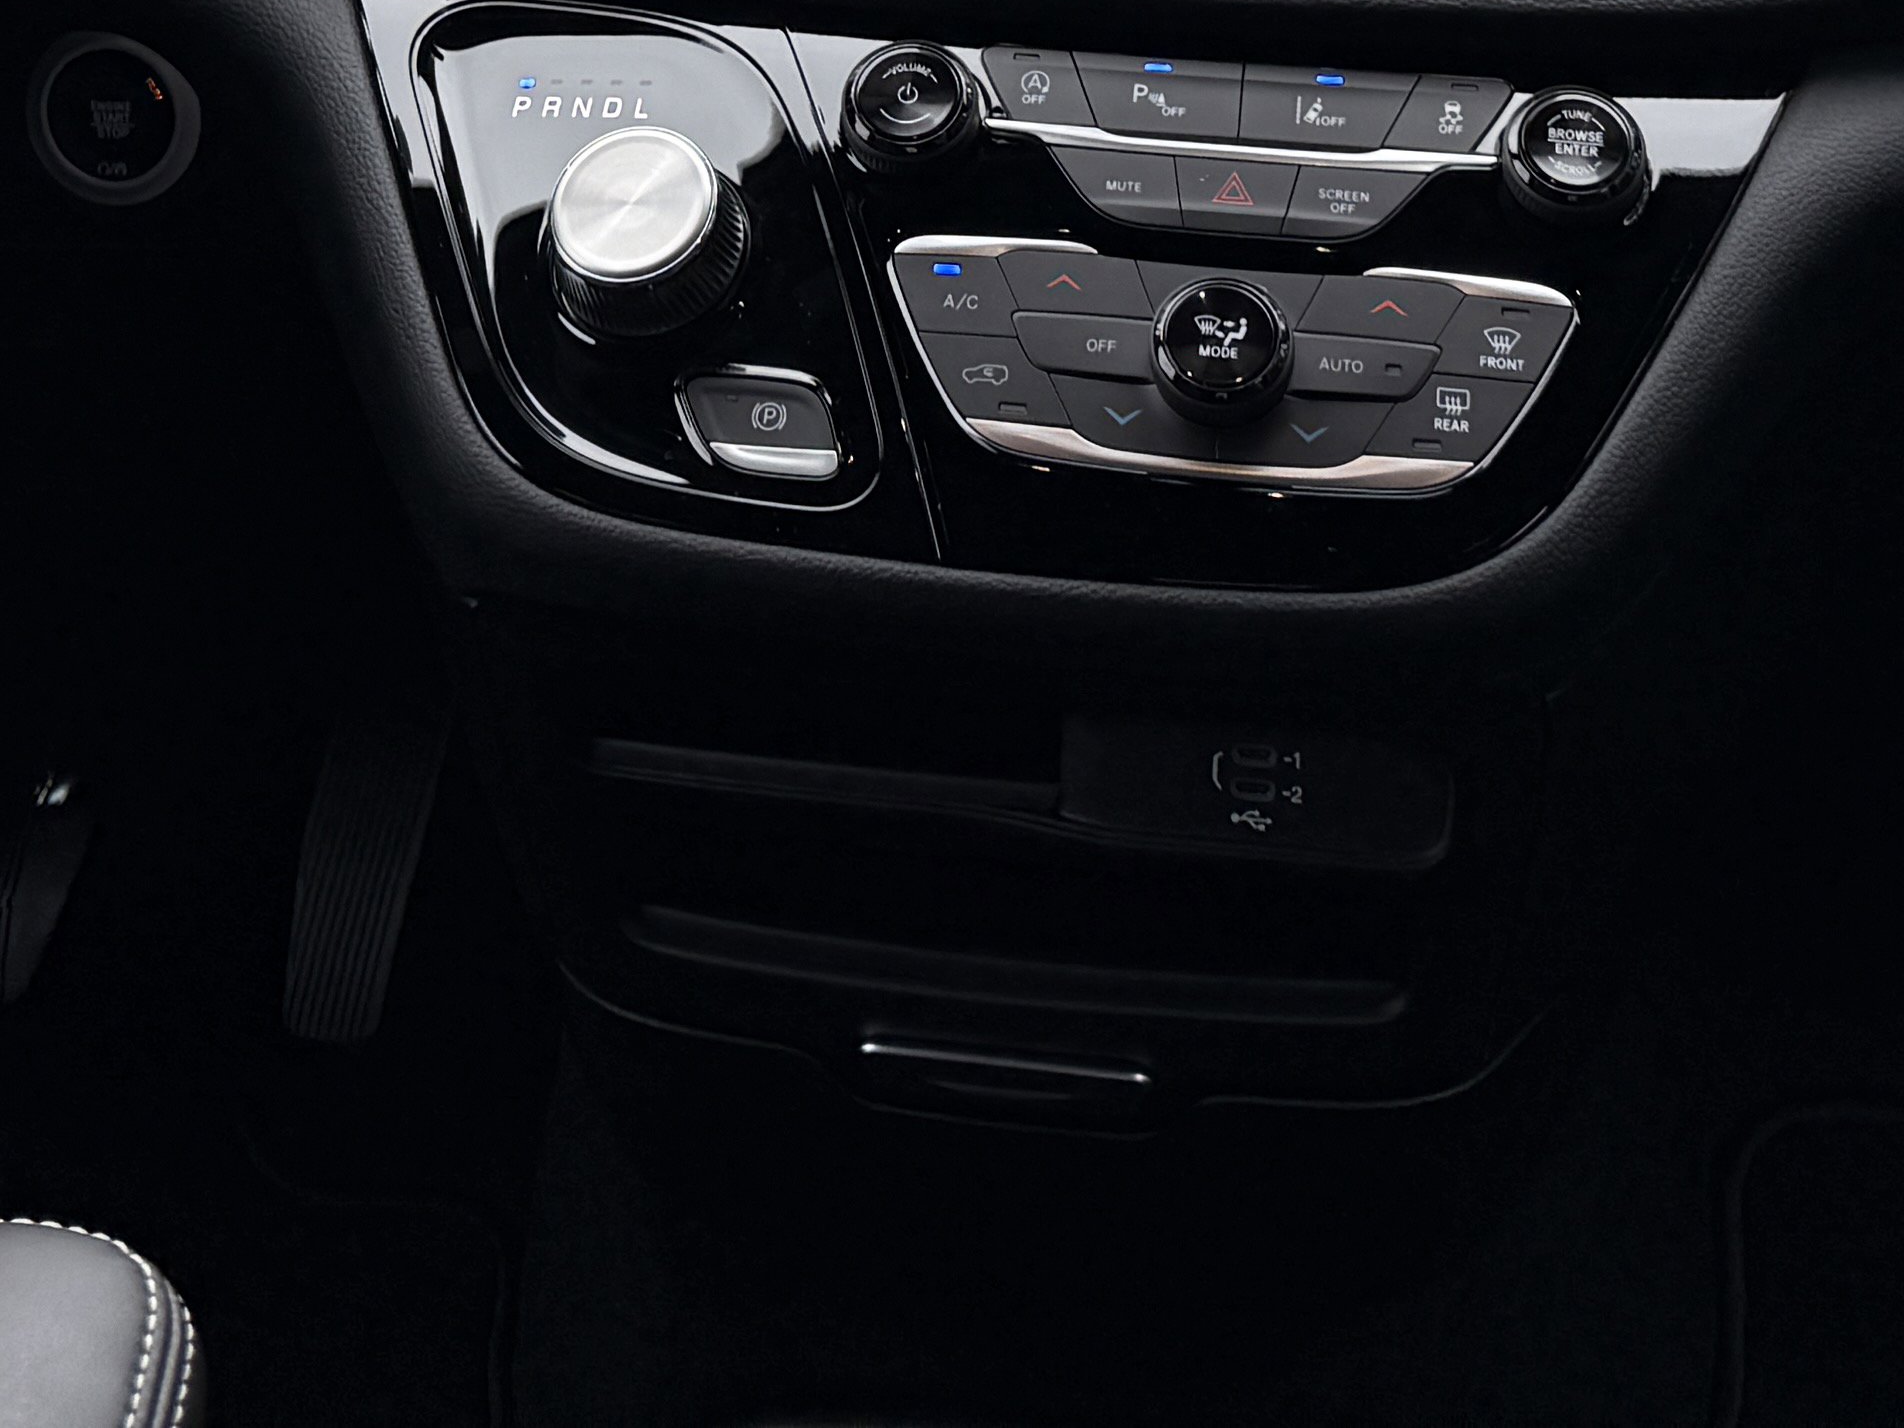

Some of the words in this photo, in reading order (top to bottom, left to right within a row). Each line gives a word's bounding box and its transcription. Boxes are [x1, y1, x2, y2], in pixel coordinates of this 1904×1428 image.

[888, 61, 932, 76] VOLUME
[1022, 94, 1046, 104] OFF
[1161, 106, 1186, 117] OFF
[1561, 109, 1593, 123] TUNE
[1321, 116, 1346, 127] OFF
[1439, 124, 1463, 135] OFF
[1548, 127, 1604, 144] BROWSE
[1555, 143, 1600, 157] ENTER
[1554, 159, 1598, 176] SCROLL
[1106, 180, 1142, 192] MUTE
[1318, 188, 1370, 202] SCREEN
[1330, 203, 1356, 214] OFF
[943, 294, 979, 310] A/C
[1086, 339, 1117, 353] OFF
[1198, 346, 1239, 360] MODE
[1319, 357, 1364, 374] AUTO
[1479, 355, 1526, 372] FRONT
[1434, 418, 1470, 433] REAR
